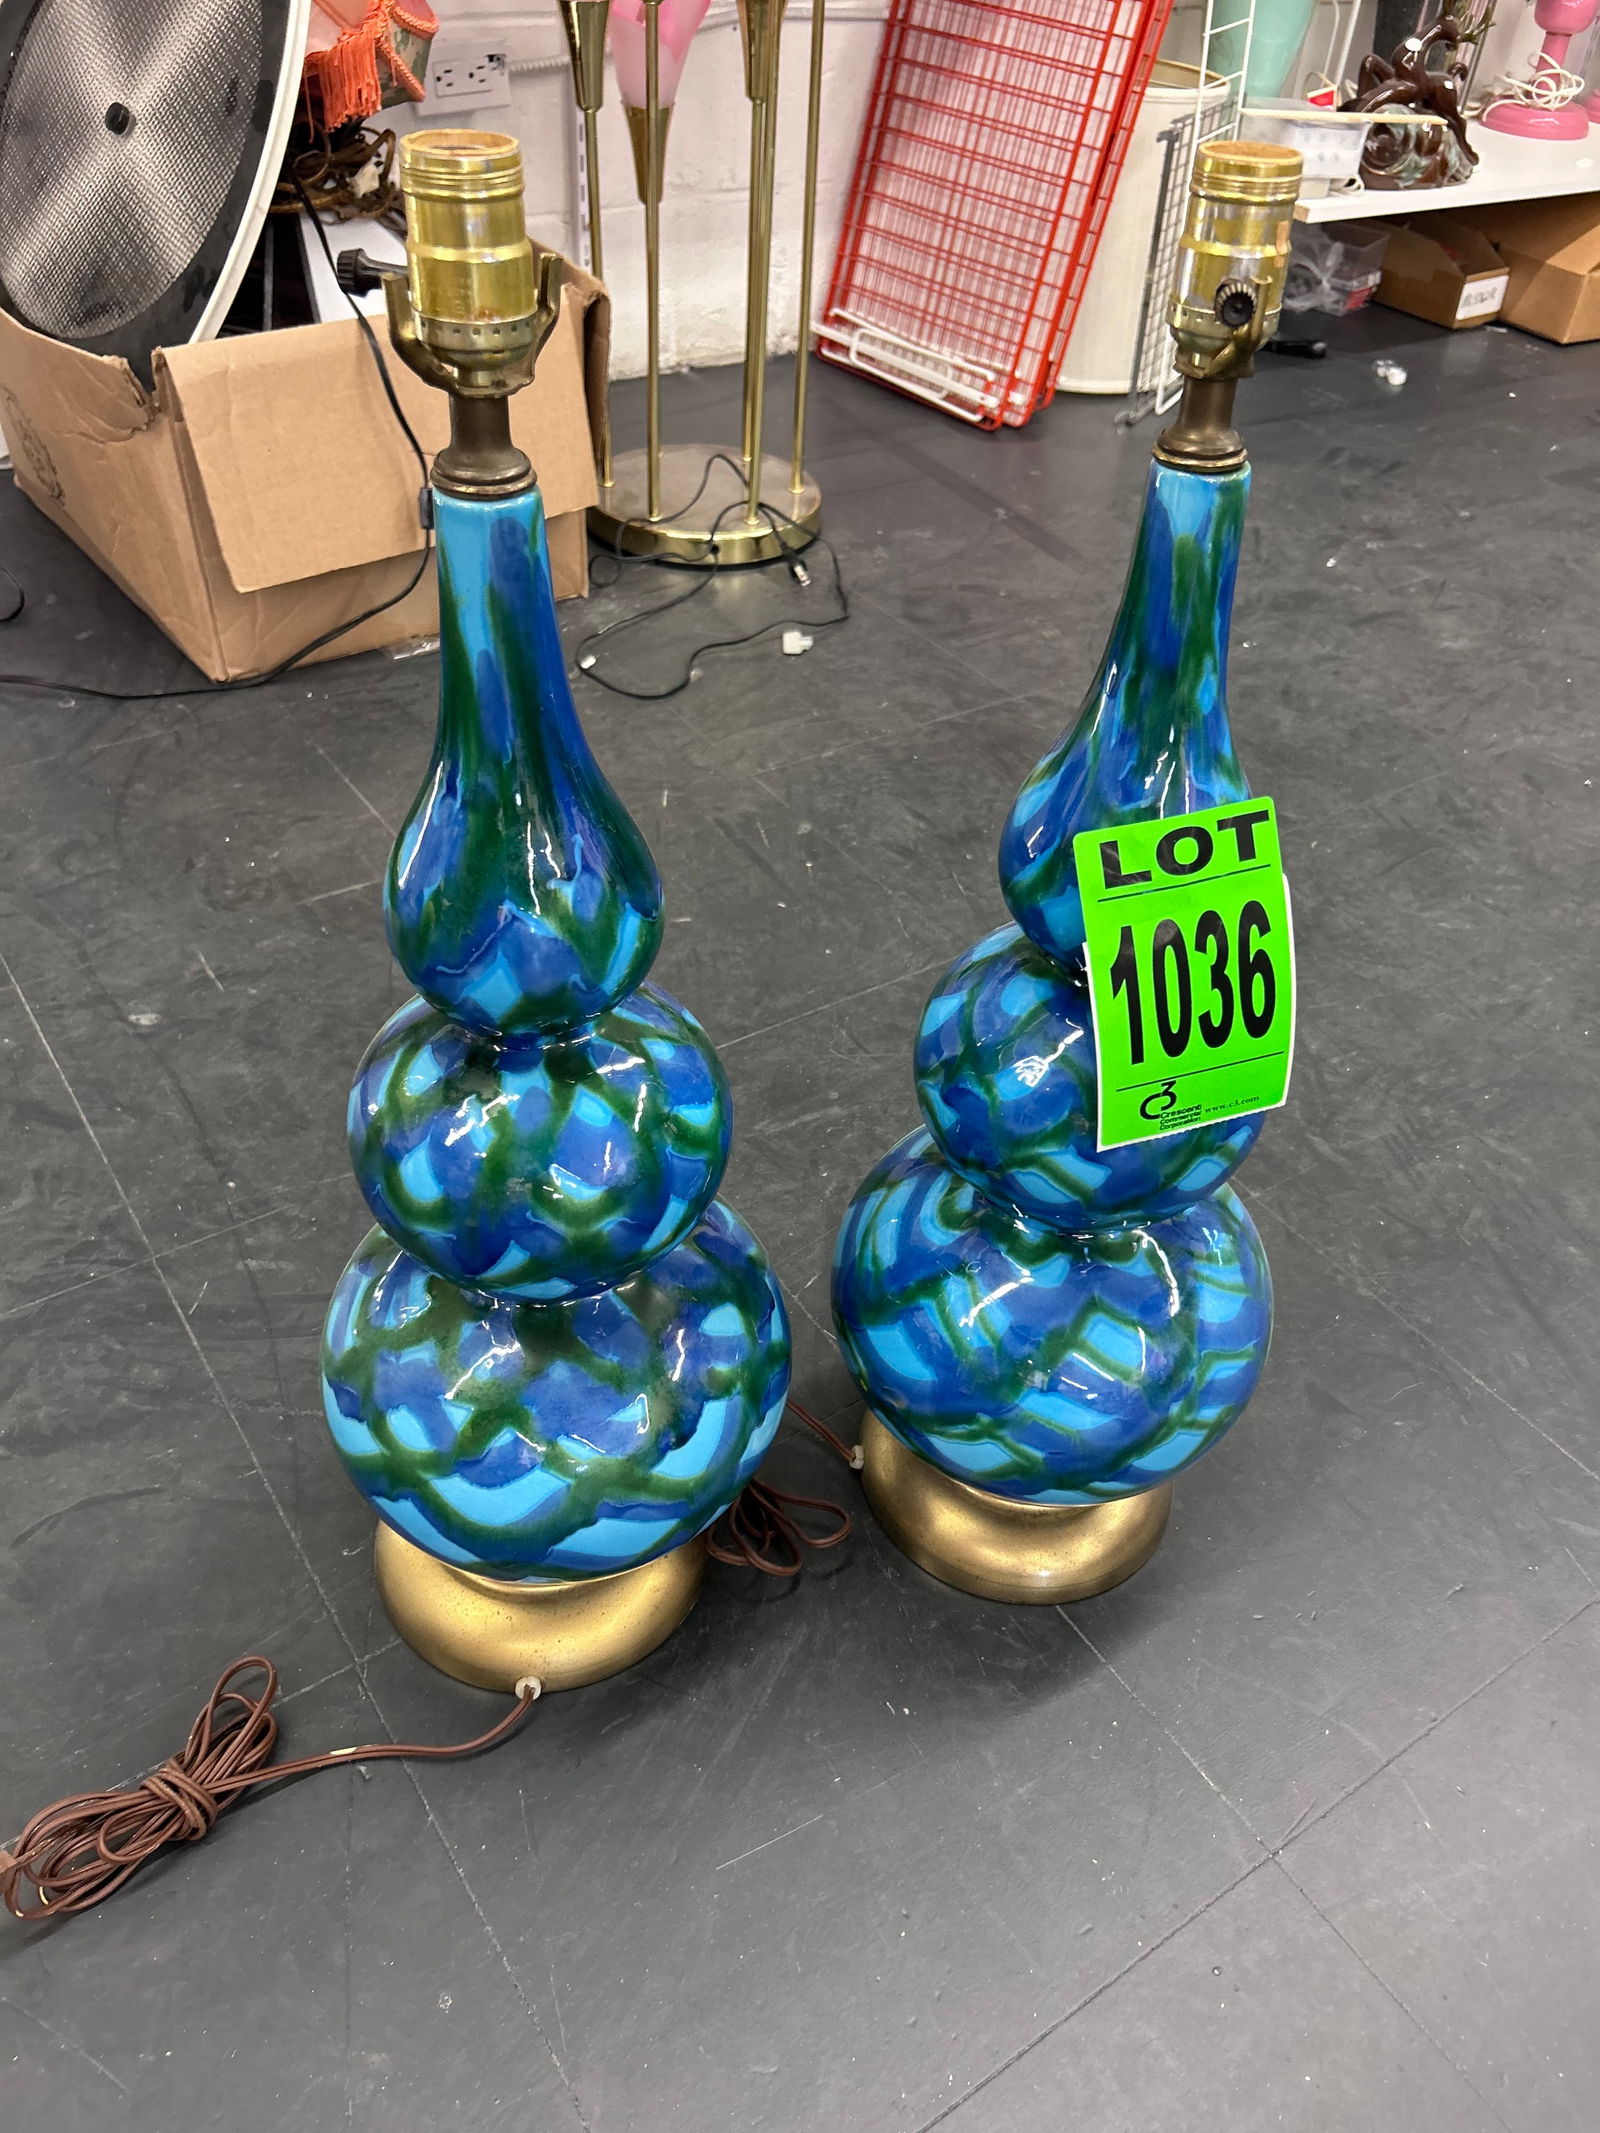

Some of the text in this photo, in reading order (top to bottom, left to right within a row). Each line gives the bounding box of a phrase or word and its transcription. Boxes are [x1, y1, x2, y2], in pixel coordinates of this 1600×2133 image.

[1099, 809, 1269, 889] LOT
[1110, 900, 1276, 1065] 1036
[1160, 1104, 1202, 1119] Crescent
[1205, 1096, 1259, 1113] www.c3.com
[1160, 1111, 1202, 1125] Commercial
[1160, 1117, 1200, 1130] Corporation
